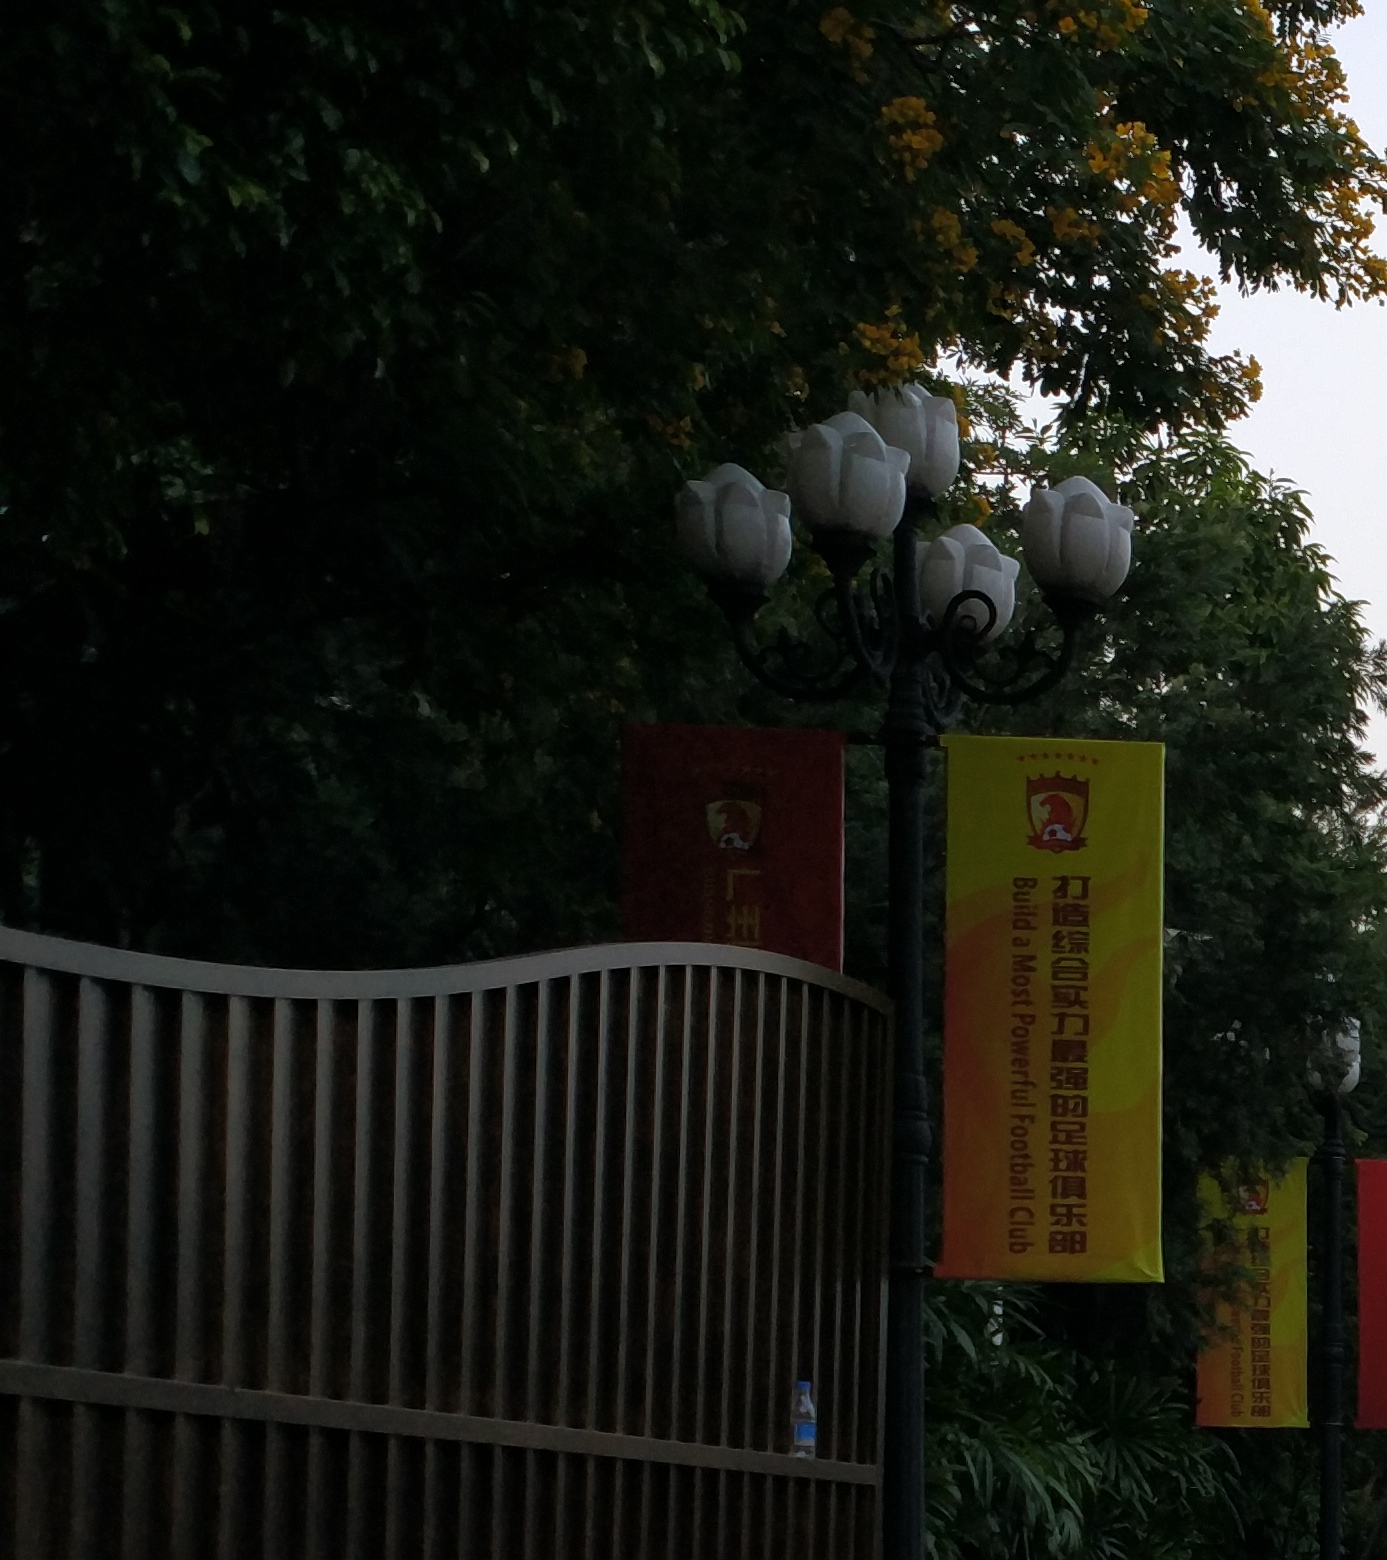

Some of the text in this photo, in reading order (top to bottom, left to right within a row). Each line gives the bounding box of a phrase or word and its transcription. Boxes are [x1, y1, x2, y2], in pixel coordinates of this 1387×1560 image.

[725, 868, 762, 946] 广州
[1007, 876, 1038, 1255] Build a Most Powerful Football Club
[1048, 874, 1092, 1255] 打造综合实力最强的足球俱乐部
[1230, 1393, 1245, 1418] Club
